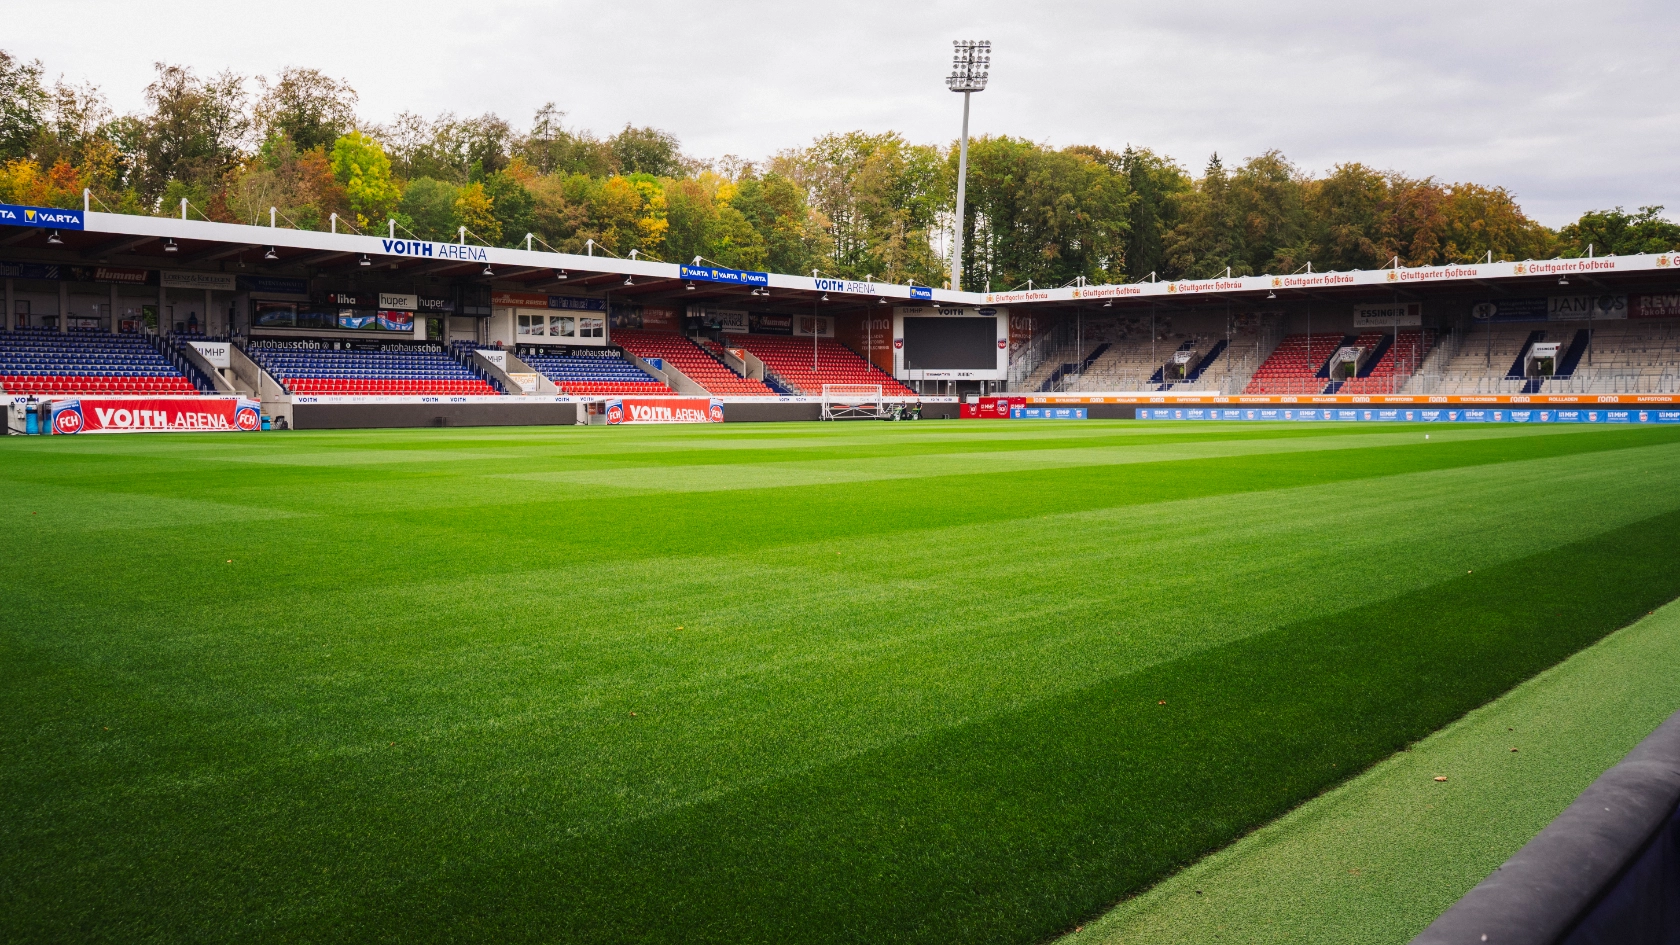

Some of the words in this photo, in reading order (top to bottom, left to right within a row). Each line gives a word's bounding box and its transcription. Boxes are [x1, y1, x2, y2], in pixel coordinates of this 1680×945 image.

[38, 212, 80, 224] VARTA
[382, 240, 432, 256] VOITH
[438, 245, 487, 261] ARENA
[1529, 263, 1576, 273] Stuttgarter
[1579, 261, 1615, 271] Hofbräu
[96, 268, 148, 281] Hummel
[1400, 270, 1442, 280] Stuttgarter
[1445, 268, 1477, 278] Hofbräu
[814, 279, 843, 291] VOITH
[847, 282, 875, 293] ARENA
[1179, 283, 1214, 292] Stuttgarter
[1216, 281, 1242, 291] Hofbräu
[1284, 277, 1322, 286] Stuttgarter
[1324, 275, 1353, 285] Hofbräu
[338, 294, 356, 304] liha
[1082, 289, 1115, 297] Stuttgarter
[1551, 295, 1624, 312] JANTOS
[1640, 295, 1680, 308] REW
[1361, 308, 1404, 317] ESSINGER
[251, 339, 320, 349] autohausschön
[381, 343, 442, 352] autohausschön
[572, 349, 620, 357] autohausschön
[95, 408, 168, 427] VOITH
[175, 412, 229, 428] ARENA
[630, 405, 671, 420] VOITH
[675, 409, 706, 420] ARENA
[60, 416, 78, 428] FCH
[239, 414, 256, 425] FCH
